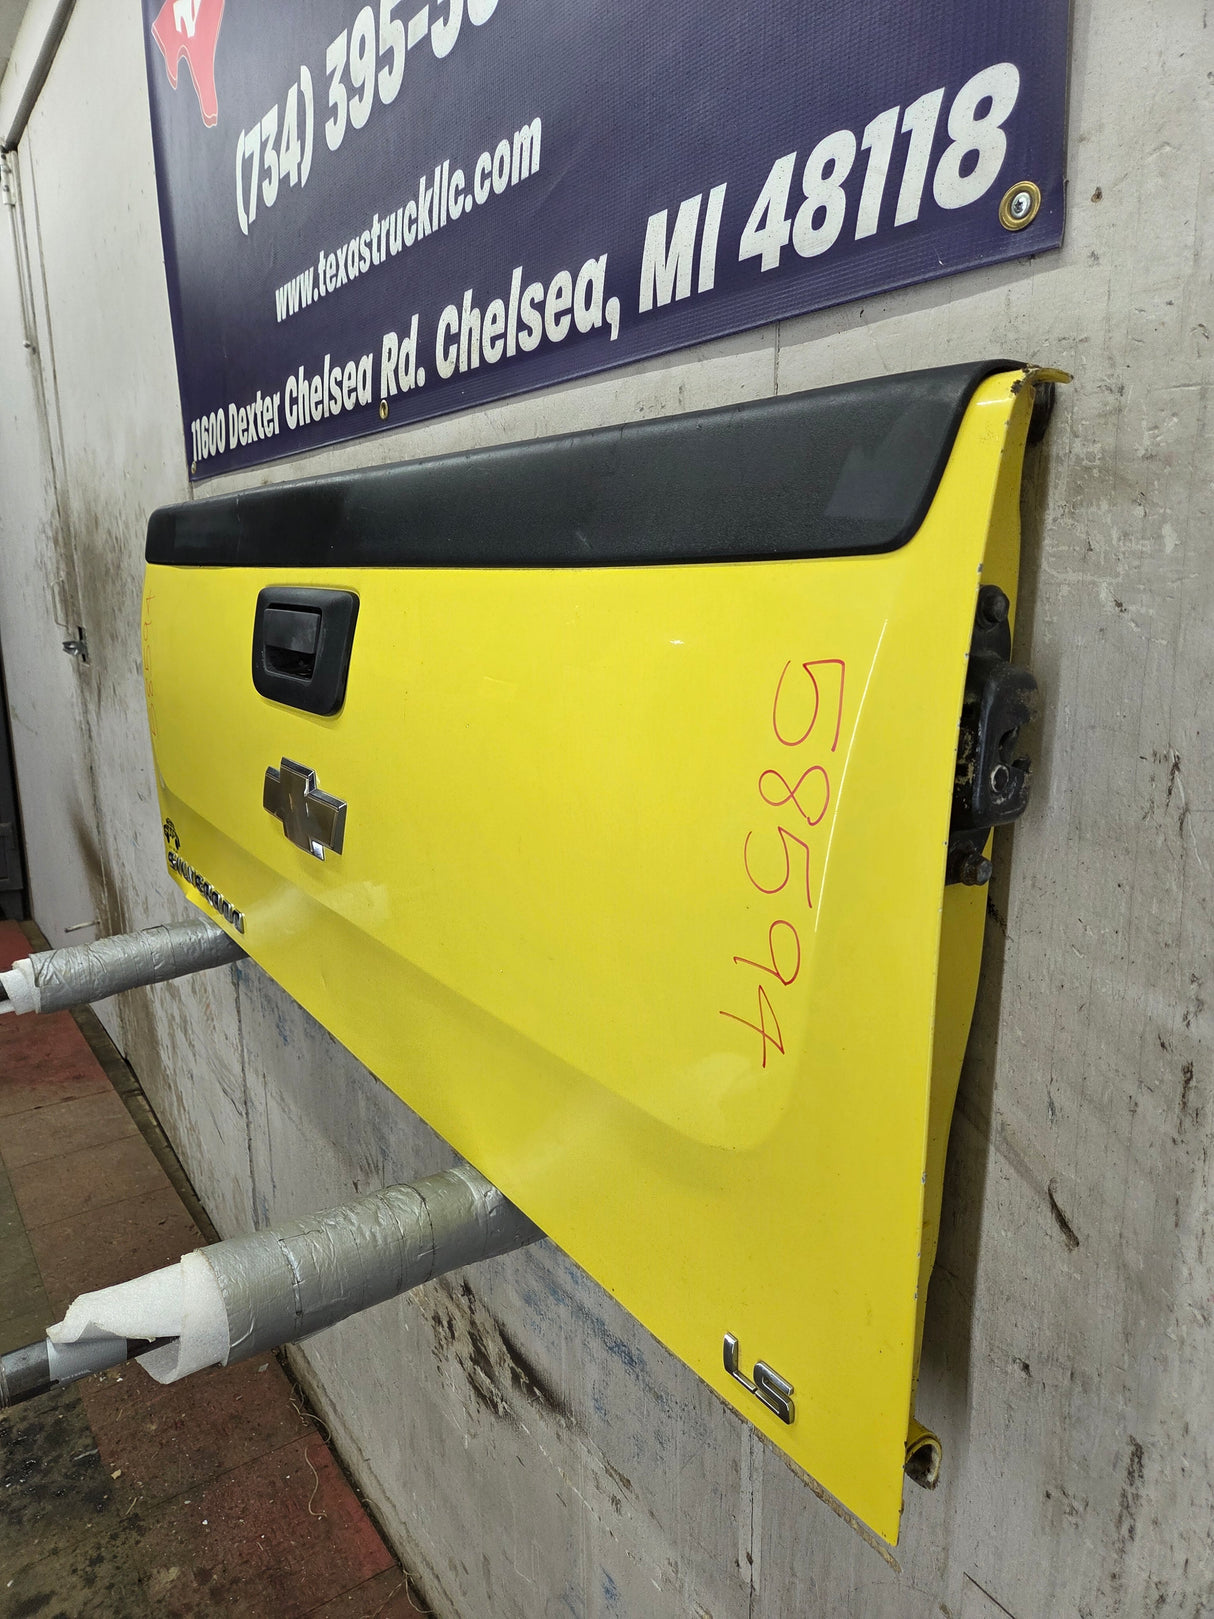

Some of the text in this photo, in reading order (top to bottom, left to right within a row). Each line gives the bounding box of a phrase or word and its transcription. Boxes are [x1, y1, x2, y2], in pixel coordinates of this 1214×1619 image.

[235, 65, 314, 235] (734)
[275, 117, 543, 323] www.texastruckllc.com
[191, 62, 1021, 462] 11600 Dexter Chelsea Rd. Chelsea, MI 48118
[719, 658, 845, 1068] 58594
[723, 1331, 796, 1426] LS
